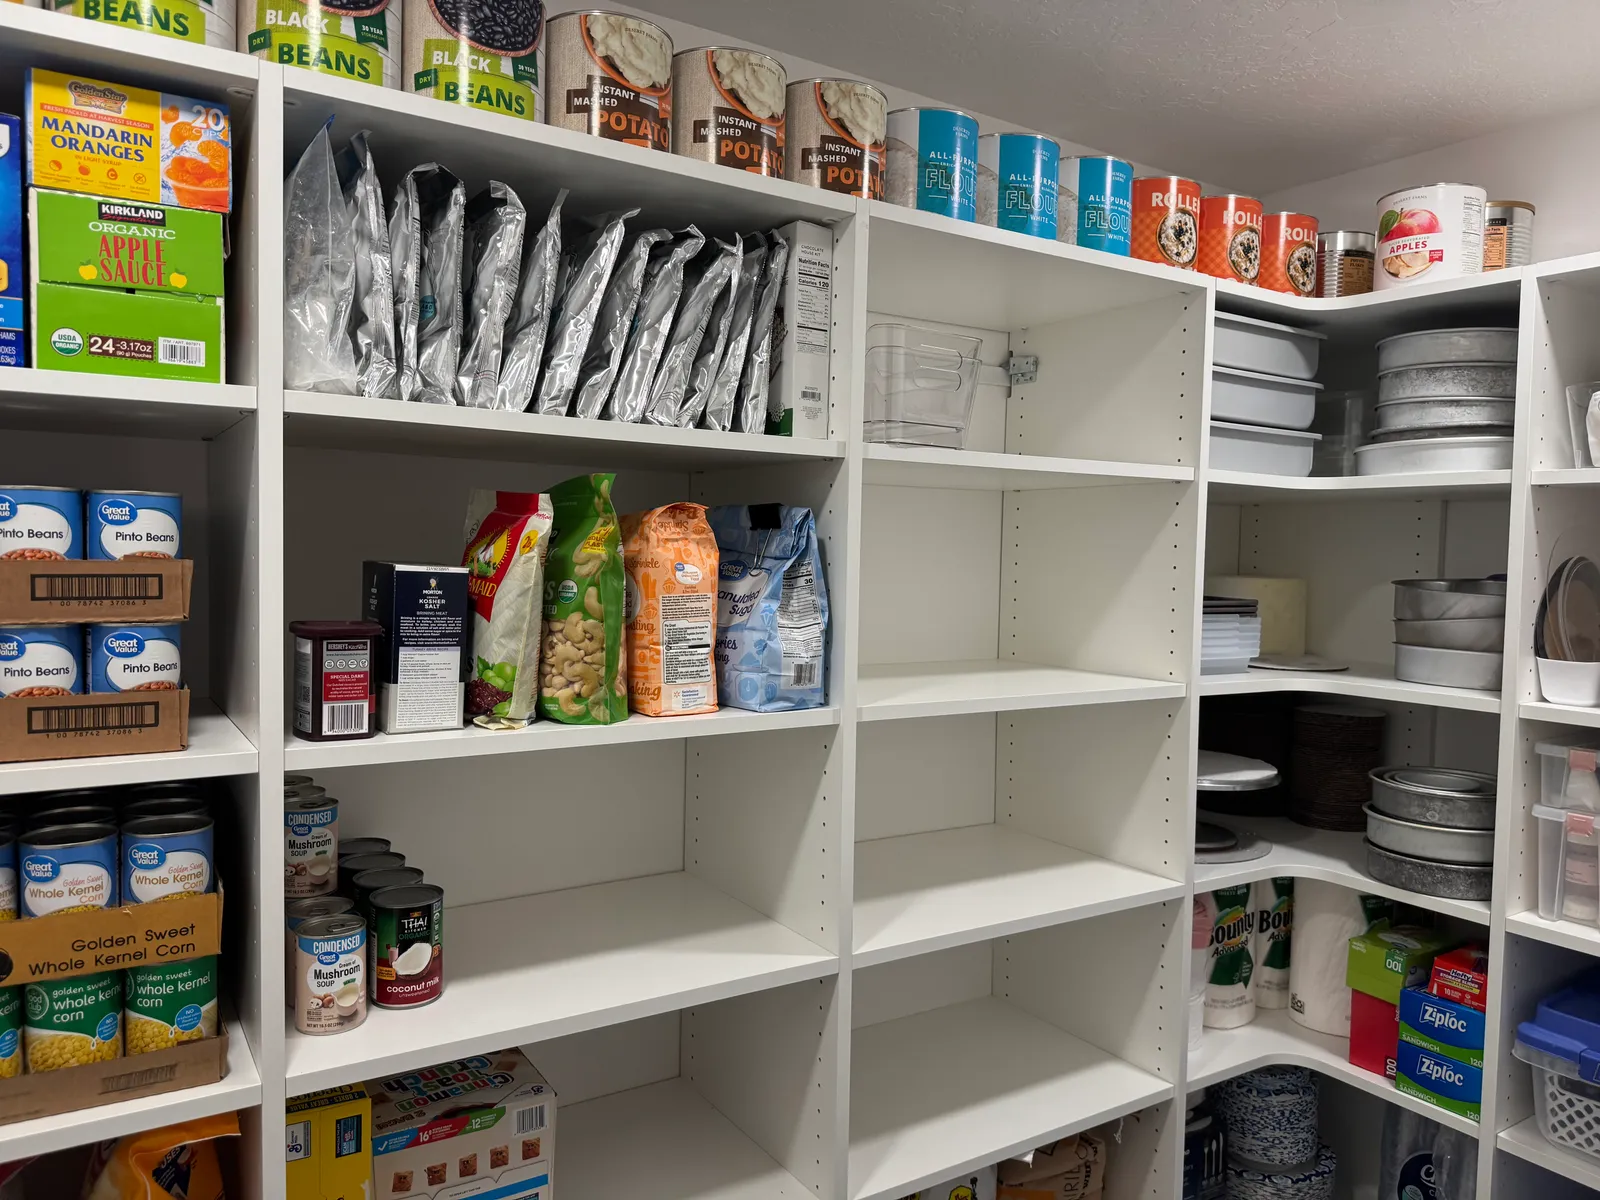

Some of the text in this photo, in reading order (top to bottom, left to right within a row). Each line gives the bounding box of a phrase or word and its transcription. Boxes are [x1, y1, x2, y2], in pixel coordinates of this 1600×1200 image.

[84, 0, 189, 37] BEANS
[265, 9, 329, 34] BLACK
[362, 24, 384, 36] 30 YEAR
[252, 36, 265, 47] DRY
[278, 43, 371, 80] BEANS
[432, 50, 491, 73] BLACK
[419, 75, 432, 85] DRY
[444, 82, 525, 116] BEANS
[574, 97, 618, 107] MASHED
[44, 104, 150, 129] FRESH PACKED AT HARVEST SEASON
[192, 105, 225, 131] 20
[718, 115, 758, 131] INSTANT
[42, 116, 153, 149] MANDARIN
[598, 110, 669, 148] POTATO
[51, 135, 145, 162] ORANGES
[825, 142, 862, 157] INSTANT
[84, 156, 122, 167] LIGHT SYRUP
[720, 139, 784, 175] POTATO
[808, 154, 847, 163] MASHED
[926, 168, 976, 200] FLOU
[951, 196, 969, 206] WHITE
[102, 204, 164, 220] KIRKLAND
[1030, 214, 1049, 224] WHITE
[88, 222, 176, 240] ORGANIC
[1108, 234, 1125, 242] WHITE
[99, 234, 167, 264] APPLE
[801, 244, 824, 253] CHOCOLATE
[1390, 240, 1428, 255] APPLES
[798, 258, 817, 266] Nutrition
[100, 257, 168, 287] SAUCE
[798, 278, 817, 286] Calories
[58, 334, 77, 342] USDA
[55, 342, 80, 351] ORGANIC
[90, 336, 115, 354] 24
[102, 504, 131, 515] Great
[108, 512, 131, 521] Value
[28, 529, 64, 539] Beans
[116, 532, 175, 543] Pinto Beans
[720, 563, 744, 573] Great
[722, 570, 740, 578] Value
[108, 638, 138, 649] Great
[114, 646, 138, 654] Value
[4, 666, 70, 677] Pinto Beans
[123, 662, 178, 674] Pinto Beans
[288, 811, 332, 826] CONDENSED
[288, 837, 332, 850] Mushroom
[132, 850, 159, 860] Great
[137, 857, 159, 865] Value
[26, 861, 53, 872] Great
[168, 862, 204, 875] Golden Sweet
[31, 869, 53, 878] Value
[135, 870, 204, 886] Whole Kernel
[63, 874, 104, 888] Golden Sweet
[182, 879, 204, 891] Corn
[29, 888, 65, 899] Whole
[68, 881, 104, 897] Kernel
[80, 893, 104, 904] Corn
[401, 916, 428, 930] THAI
[72, 923, 196, 952] Golden Sweet
[398, 930, 431, 940] ORGANIC
[313, 934, 360, 954] CONDENSED
[1212, 937, 1249, 958] Advanced
[29, 942, 196, 976] Whole Kernel Corn
[1386, 958, 1402, 973] 100
[136, 968, 193, 984] golden sweet
[314, 964, 361, 980] Mushroom
[1451, 970, 1472, 981] Hefty
[137, 971, 211, 995] whole kernel
[316, 980, 335, 988] SOUP
[386, 976, 440, 993] coconut milk
[1440, 972, 1479, 989] STORAGE SLIDER
[52, 977, 111, 999] golden sweet
[1444, 988, 1451, 996] 10
[53, 994, 96, 1011] whole
[137, 998, 163, 1008] corn
[53, 1010, 84, 1023] corn
[106, 1017, 114, 1025] NO
[1423, 1005, 1467, 1033] Ziploc
[5, 1033, 13, 1041] NO
[1401, 1033, 1440, 1053] SANDWICH
[1386, 1058, 1397, 1077] 100
[1469, 1057, 1483, 1069] 120
[1421, 1058, 1465, 1087] Ziploc
[334, 1094, 354, 1102] BOXES
[1399, 1083, 1437, 1105] SANDWICH
[290, 1103, 310, 1112] VALUE
[1466, 1110, 1480, 1122] 120
[472, 1118, 481, 1129] 12
